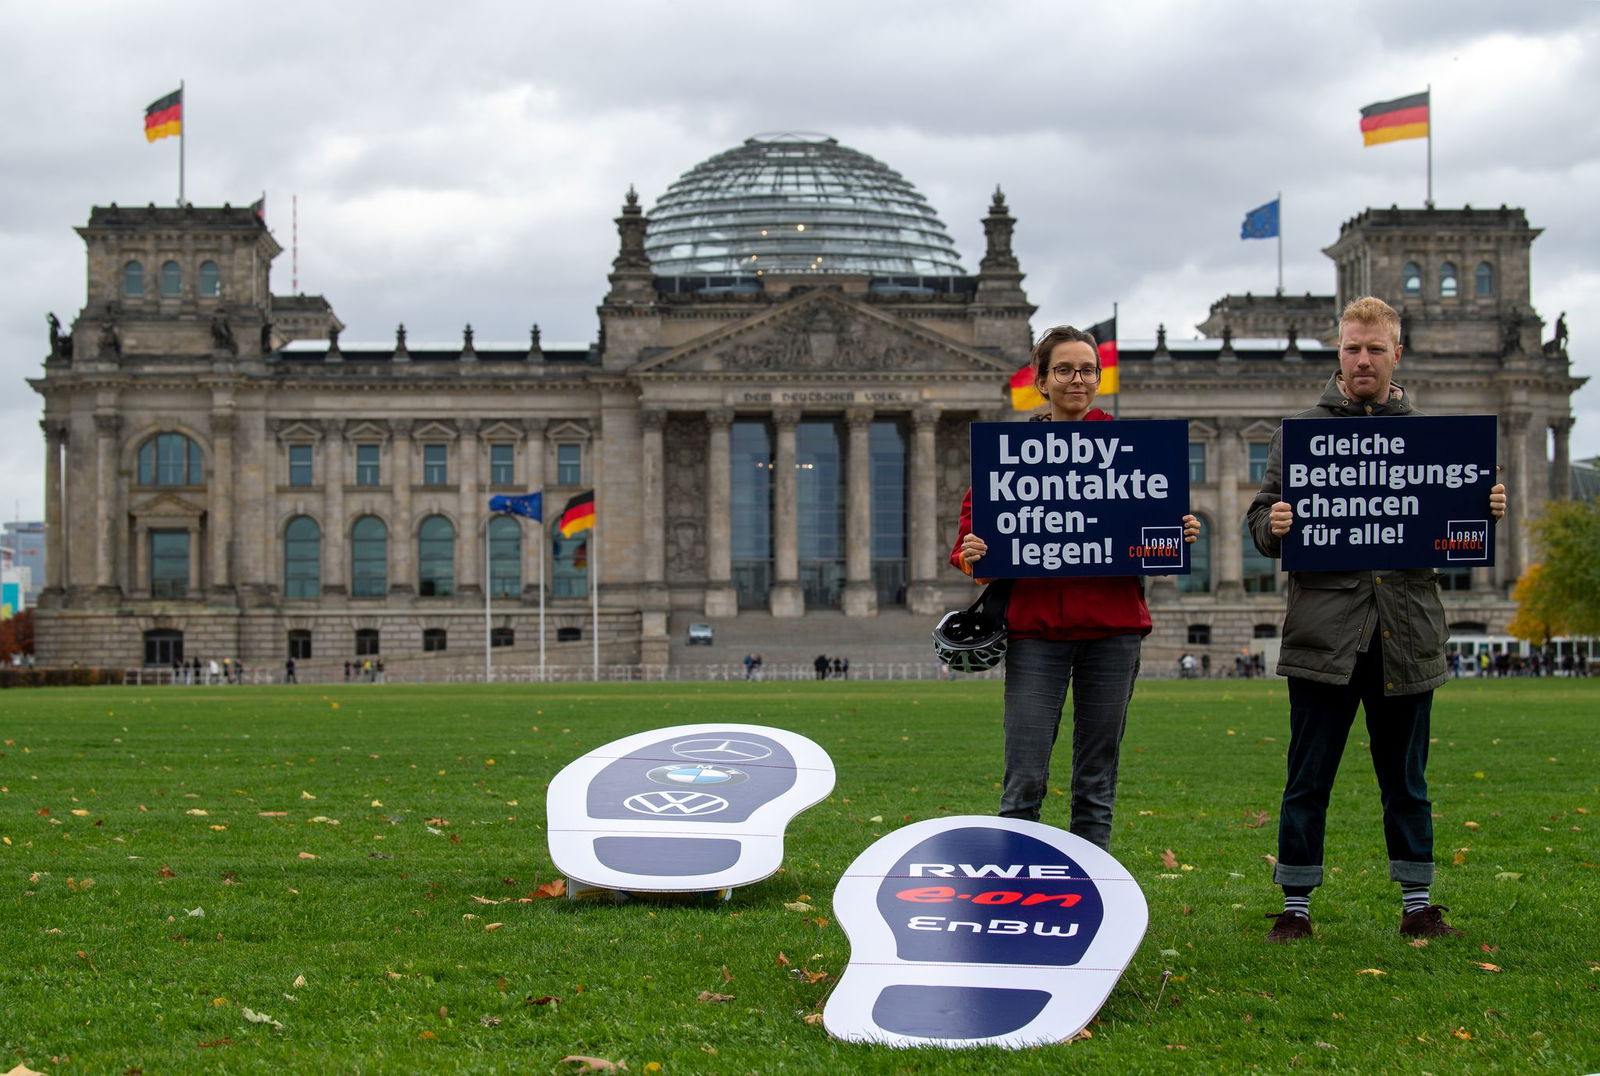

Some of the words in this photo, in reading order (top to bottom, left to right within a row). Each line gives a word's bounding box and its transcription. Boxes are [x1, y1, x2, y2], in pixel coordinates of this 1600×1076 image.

[999, 432, 1134, 469] Lobby-
[1309, 433, 1405, 456] Gleiche
[990, 468, 1169, 501] Kontakte
[1289, 461, 1490, 490] Beteiligungs-
[1296, 494, 1419, 518] chancen
[996, 506, 1098, 534] offen-
[1145, 538, 1180, 550] LOBBY
[1302, 524, 1341, 546] für
[1348, 523, 1404, 545] alle!
[1434, 538, 1483, 550] CONTROL
[1450, 530, 1485, 543] LOBBY
[1012, 537, 1113, 570] legen!
[1129, 545, 1179, 558] CONTROL
[909, 863, 1071, 879] RWE
[907, 916, 1079, 938] EnBW
